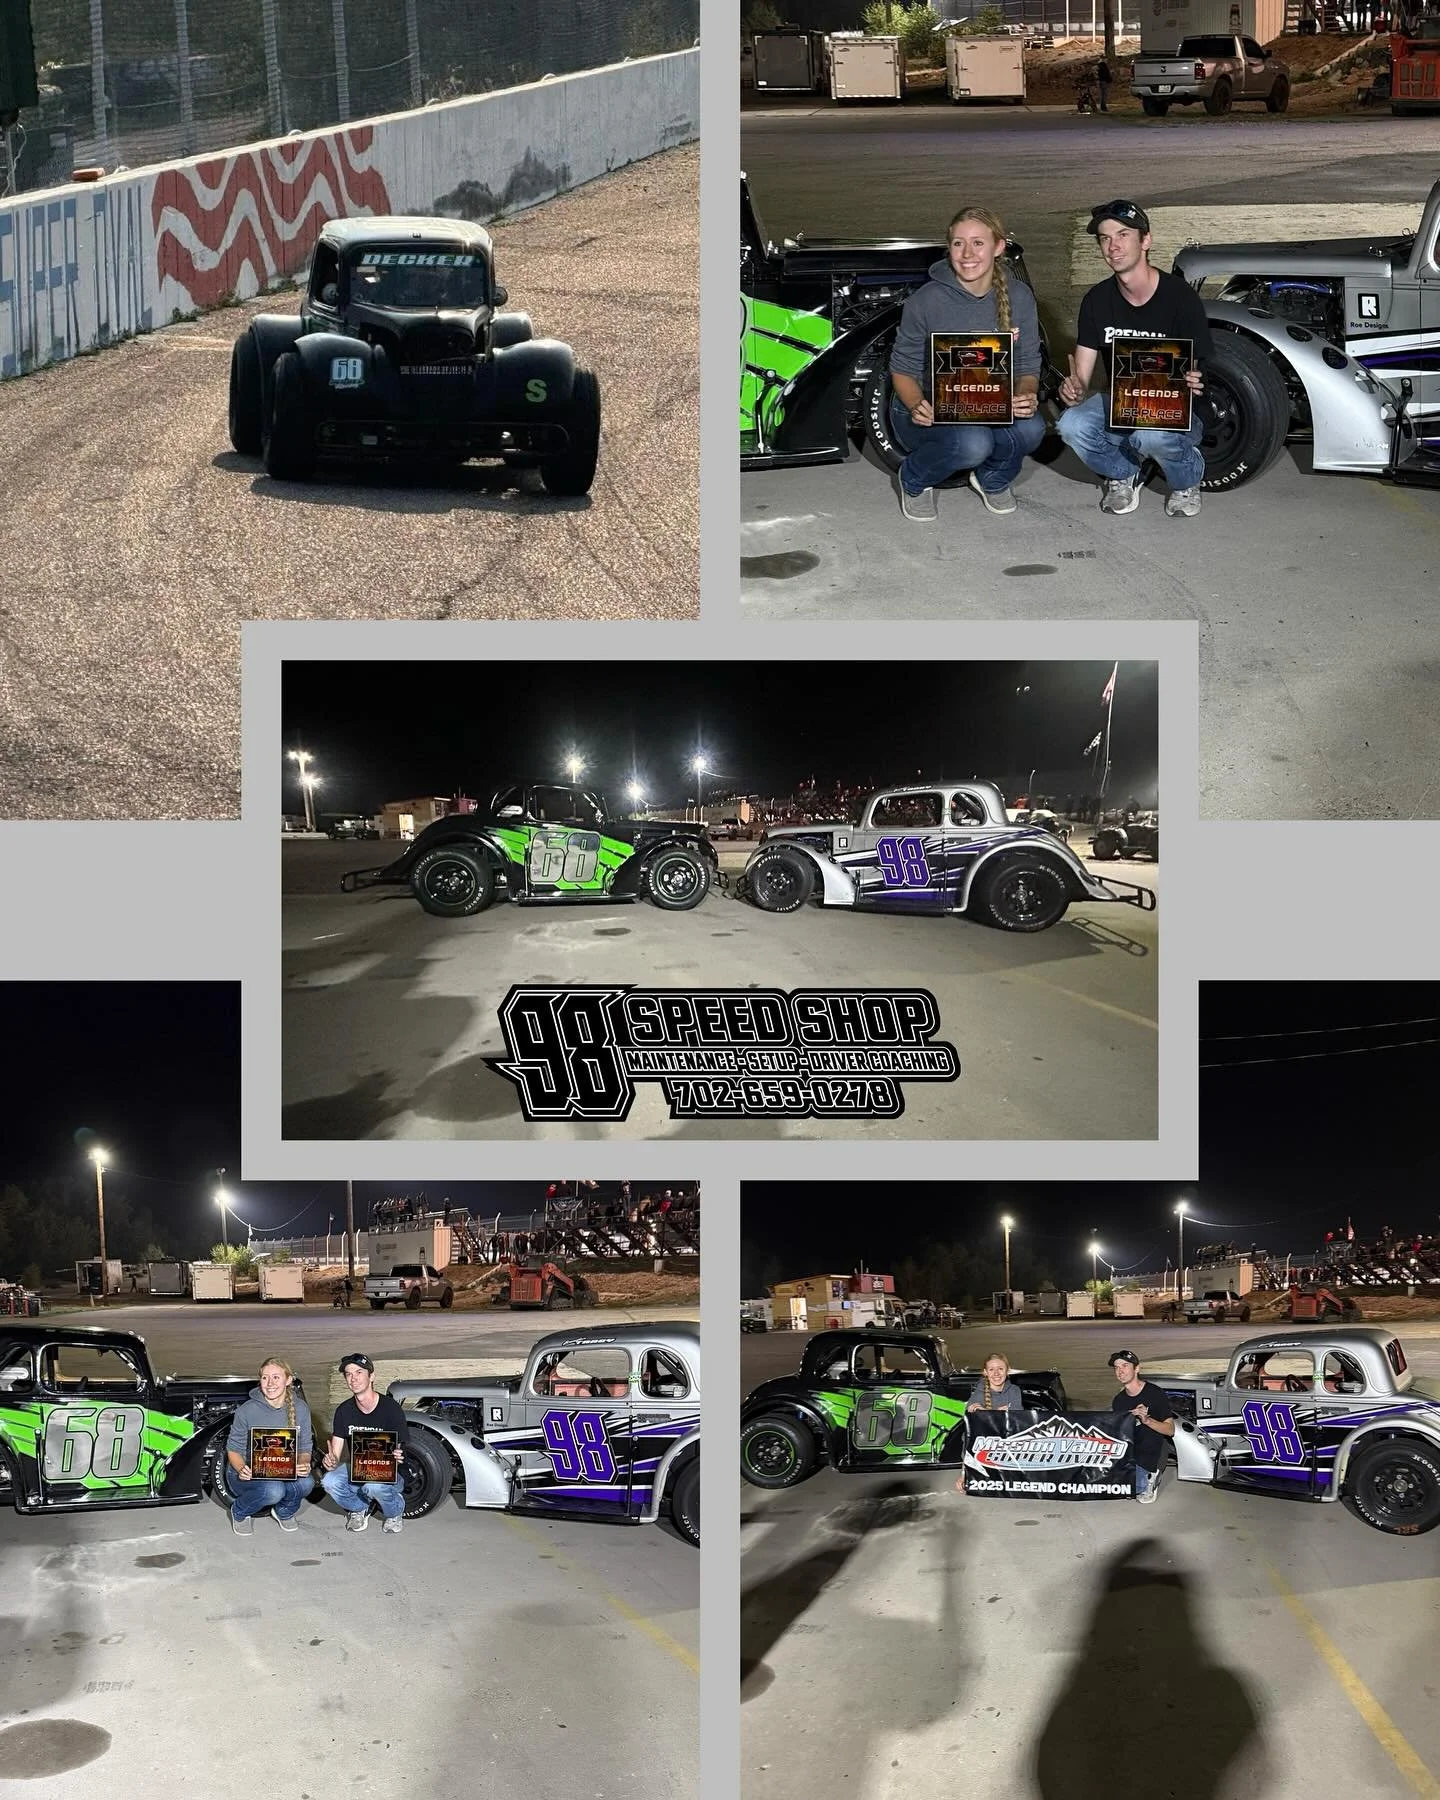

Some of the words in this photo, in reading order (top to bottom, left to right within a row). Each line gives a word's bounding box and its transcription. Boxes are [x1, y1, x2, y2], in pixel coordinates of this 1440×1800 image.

[92, 184, 153, 344] OVAL
[361, 254, 475, 267] DECKER
[1361, 296, 1377, 317] R
[1104, 327, 1166, 343] BREN
[332, 358, 361, 380] 68
[526, 379, 547, 402] S
[945, 384, 1000, 392] LEGENDS
[1124, 388, 1179, 398] LEGENDS
[965, 404, 1006, 413] PLACE
[1139, 408, 1182, 420] PLACE
[1200, 461, 1248, 487] Hoosie
[529, 831, 601, 883] 68
[876, 836, 931, 887] 98
[854, 1391, 933, 1449] 68
[1241, 1400, 1305, 1464] 98
[43, 1407, 145, 1480] 68
[541, 1409, 617, 1483] 98
[972, 1437, 1055, 1453] Mission
[1060, 1439, 1126, 1457] Valley
[986, 1452, 1054, 1463] SUPER
[1057, 1454, 1112, 1466] OVAL
[968, 1479, 1004, 1491] 2025
[1005, 1481, 1057, 1493] LEGEND
[1058, 1482, 1132, 1495] CHAMPION
